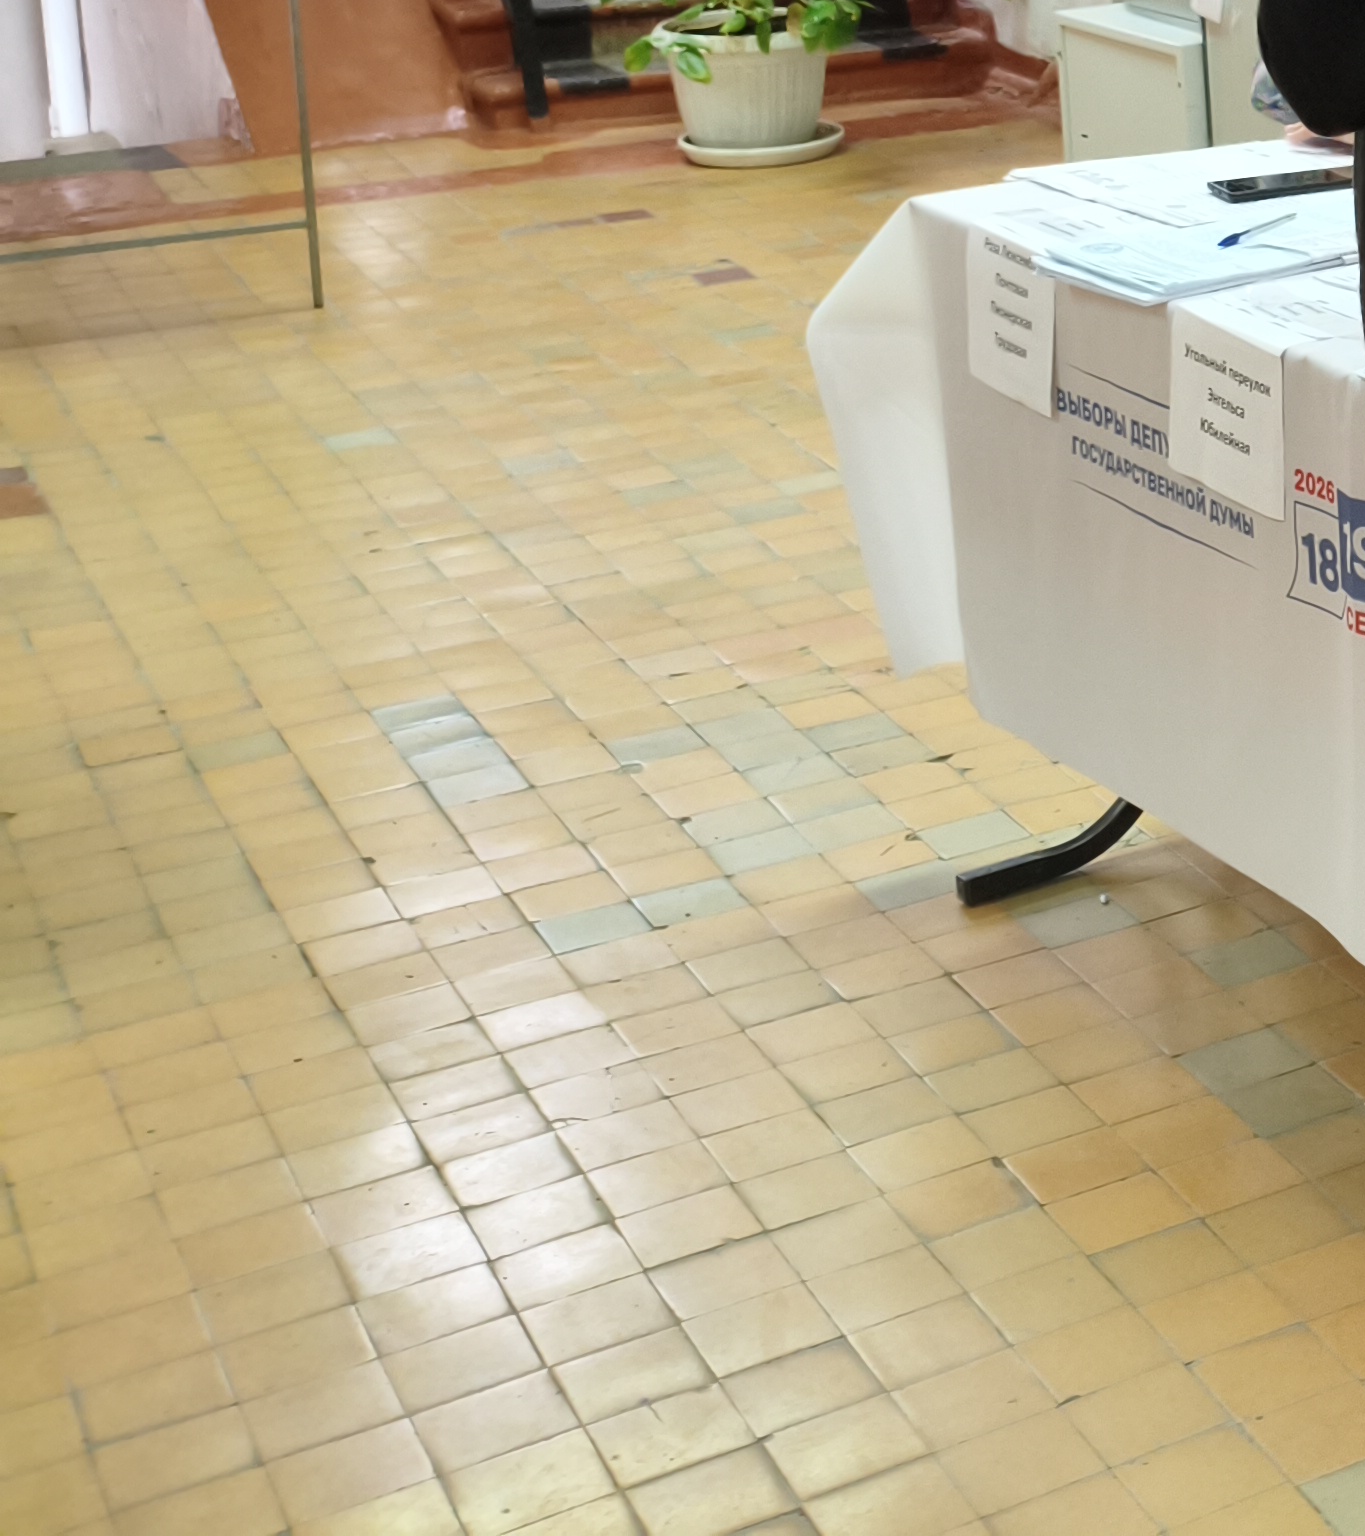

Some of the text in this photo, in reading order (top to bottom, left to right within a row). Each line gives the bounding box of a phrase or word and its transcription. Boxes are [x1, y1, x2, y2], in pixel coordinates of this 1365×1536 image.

[1184, 343, 1271, 397] Угольный переулок
[1056, 387, 1127, 439] ВЫБОРЫ
[1207, 387, 1245, 419] Энгельса
[1200, 417, 1250, 456] Юбилейная
[1071, 434, 1255, 539] ГОСУДАРСТВЕННОЙ ДУМЫ
[1294, 468, 1335, 504] 2026
[1301, 532, 1340, 593] 18
